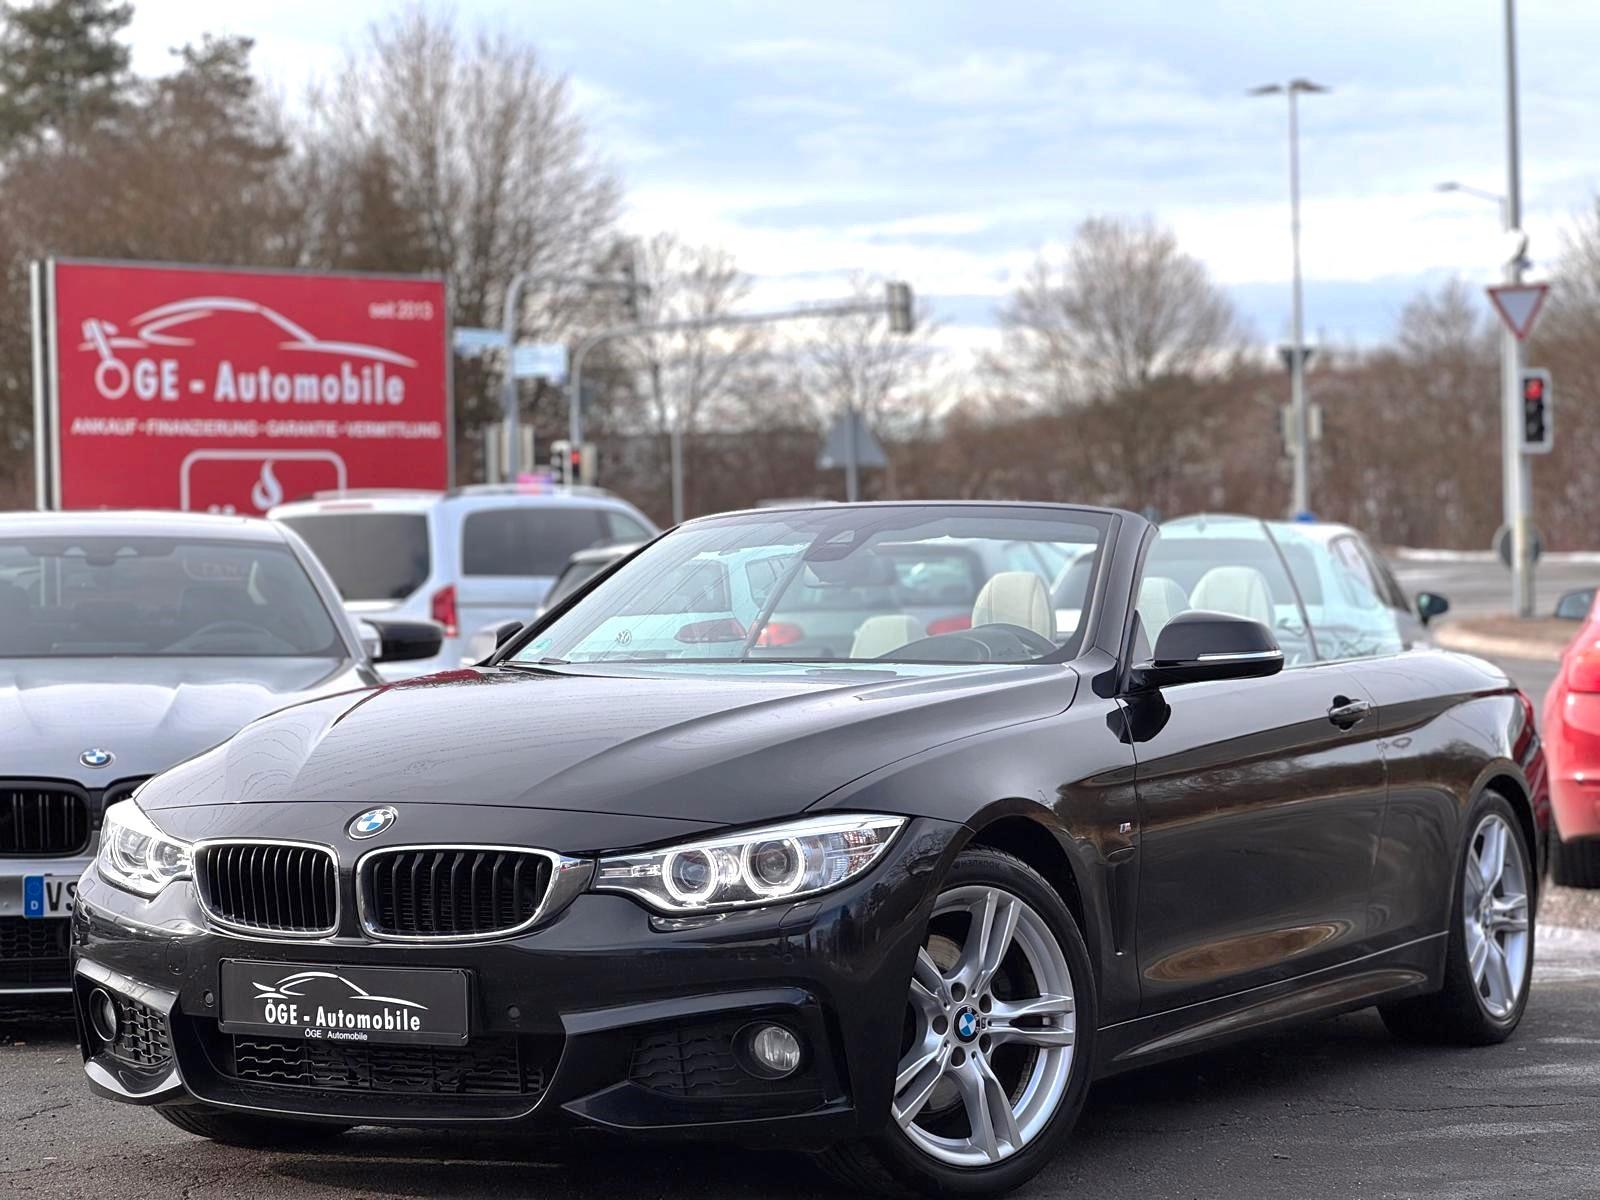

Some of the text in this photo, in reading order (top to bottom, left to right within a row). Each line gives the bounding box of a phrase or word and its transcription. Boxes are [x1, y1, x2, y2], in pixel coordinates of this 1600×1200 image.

[213, 360, 405, 405] Automobile
[264, 999, 421, 1031] ÖGE - Automobile
[304, 1028, 368, 1041] ÖGE Automobile
